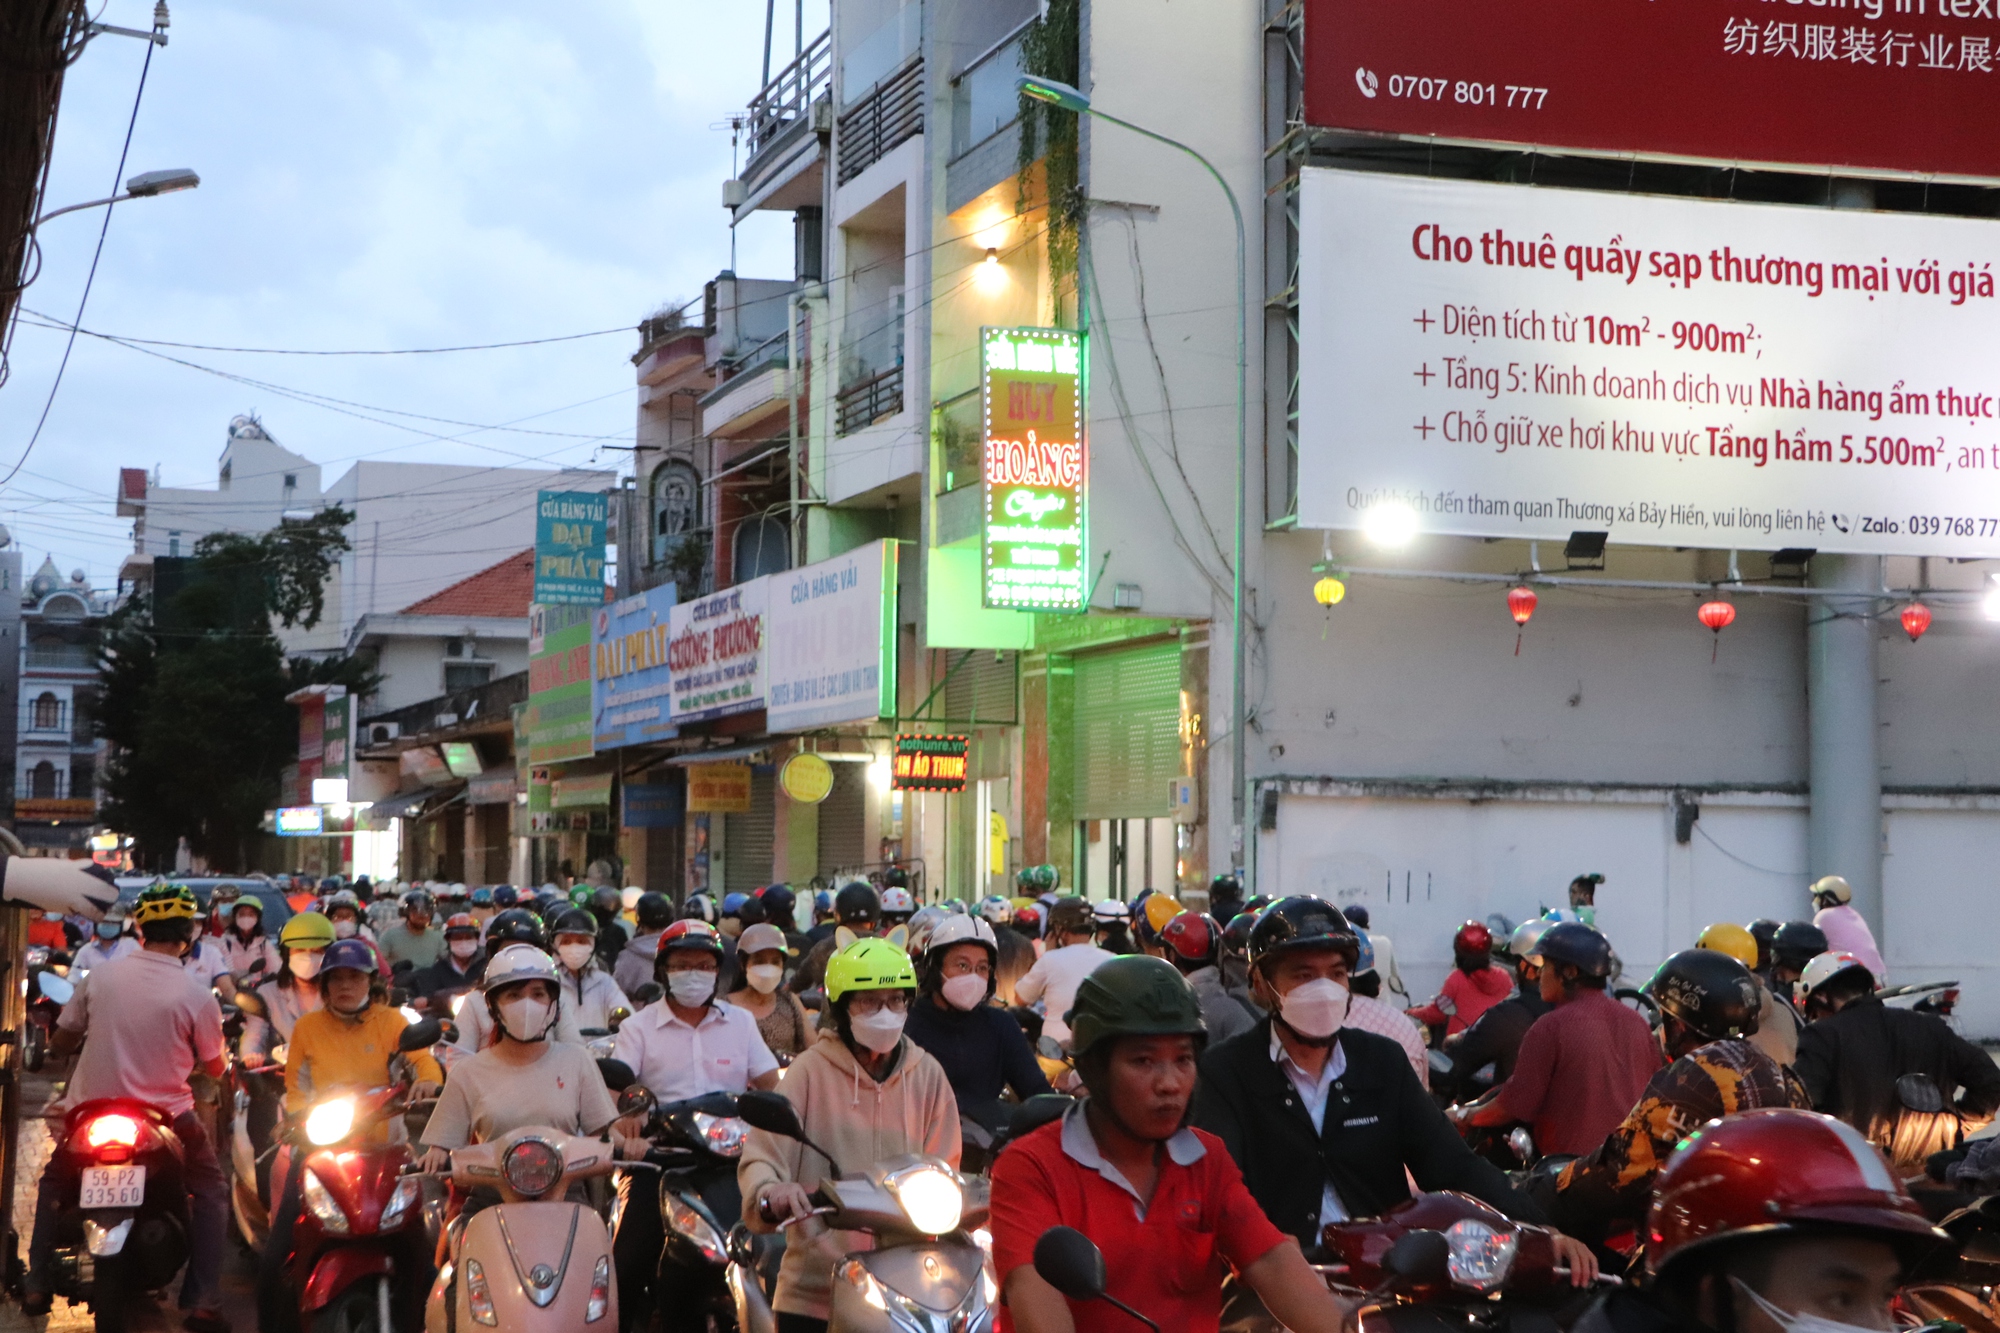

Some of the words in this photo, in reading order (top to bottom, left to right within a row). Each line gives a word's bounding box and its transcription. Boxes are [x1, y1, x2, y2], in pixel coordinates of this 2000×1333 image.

[1722, 16, 2000, 73] 纺织服装行业展
[1388, 74, 1448, 101] 0707
[1454, 81, 1496, 106] 801
[1504, 85, 1549, 110] 777
[1411, 223, 1473, 263] Cho
[1479, 228, 1557, 269] thuê
[1563, 233, 1642, 286] quầy
[1648, 250, 1703, 289] sạp
[1709, 246, 1823, 297] thương
[1831, 256, 1889, 301] mại
[1895, 258, 1940, 295] với
[1948, 261, 1995, 306] giá
[1443, 304, 1496, 344] Diện
[1502, 308, 1545, 341] tích
[1551, 312, 1578, 343] từ
[1007, 380, 1058, 421] HUY
[1442, 355, 1499, 400] Tầng
[1506, 362, 1528, 393] 5:
[1534, 363, 1586, 396] Kinh
[1593, 366, 1666, 401] doanh
[1673, 371, 1719, 410] dịch
[1726, 383, 1752, 413] vụ
[1760, 377, 1811, 410] Nhà
[1817, 380, 1883, 421] hàng
[1889, 379, 1930, 415] ẩm
[1935, 386, 1993, 426] thực
[989, 429, 1078, 488] HOÀNG
[1442, 409, 1488, 444] Chỗ
[1494, 415, 1534, 453] giữ
[1537, 424, 1564, 448] xe
[1570, 417, 1605, 450] hơi
[1612, 420, 1654, 453] khu
[1661, 430, 1701, 462] vực
[1705, 423, 1768, 467] Tầng
[1774, 427, 1833, 462] hầm
[1957, 445, 1985, 469] an
[561, 498, 585, 520] HÀNG
[587, 498, 603, 521] VẢI
[1433, 491, 1464, 514] đến
[1467, 493, 1510, 517] tham
[1513, 498, 1553, 522] quan
[1556, 497, 1614, 527] Thương
[1617, 502, 1635, 523] xá
[1639, 501, 1666, 529] Bảy
[1713, 508, 1735, 527] vui
[1738, 508, 1772, 534] lòng
[1775, 509, 1803, 531] liên
[1806, 510, 1826, 536] hệ
[1908, 515, 1940, 536] 039
[1944, 516, 1975, 537] 768
[540, 551, 603, 579] PHÁT
[791, 575, 810, 605] CỬA
[812, 571, 838, 600] HÀNG
[840, 559, 858, 590] VẢI
[625, 611, 669, 674] PHÁT
[897, 754, 911, 777] IN
[911, 750, 930, 778] ÁO
[932, 755, 965, 778] THUN
[85, 1187, 140, 1205] 335.60
